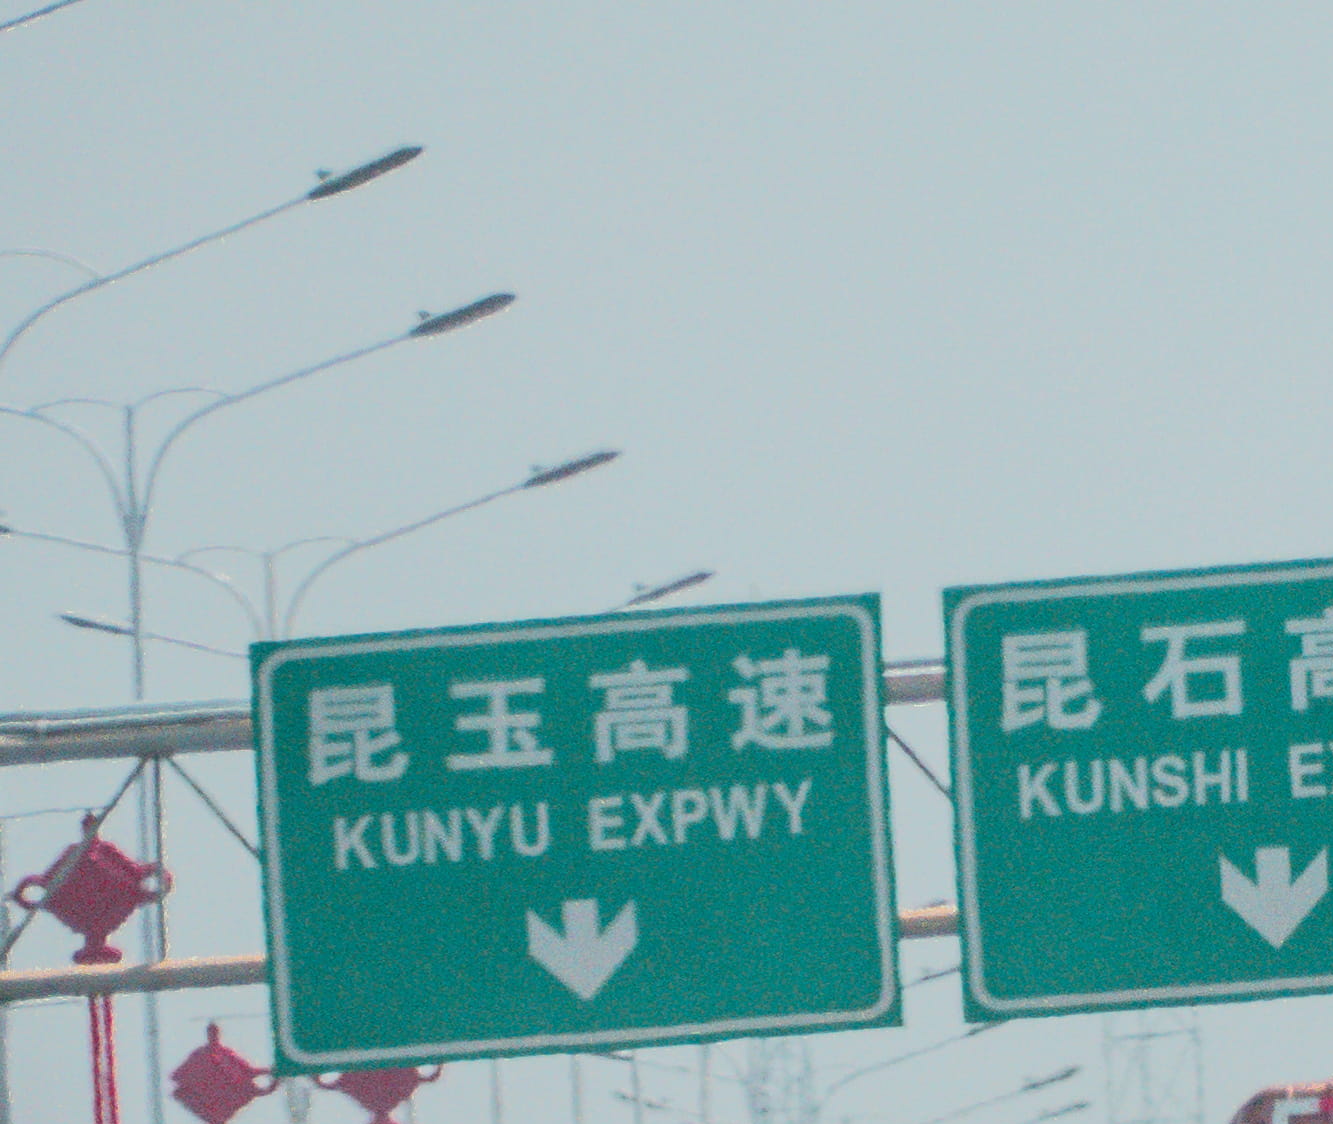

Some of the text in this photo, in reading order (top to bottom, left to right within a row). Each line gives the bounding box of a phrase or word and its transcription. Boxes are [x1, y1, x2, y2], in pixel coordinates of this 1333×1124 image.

[308, 648, 834, 787] 昆玉高速
[333, 779, 811, 870] KUNYU EXPWY
[1018, 748, 1248, 820] KUNSHI
